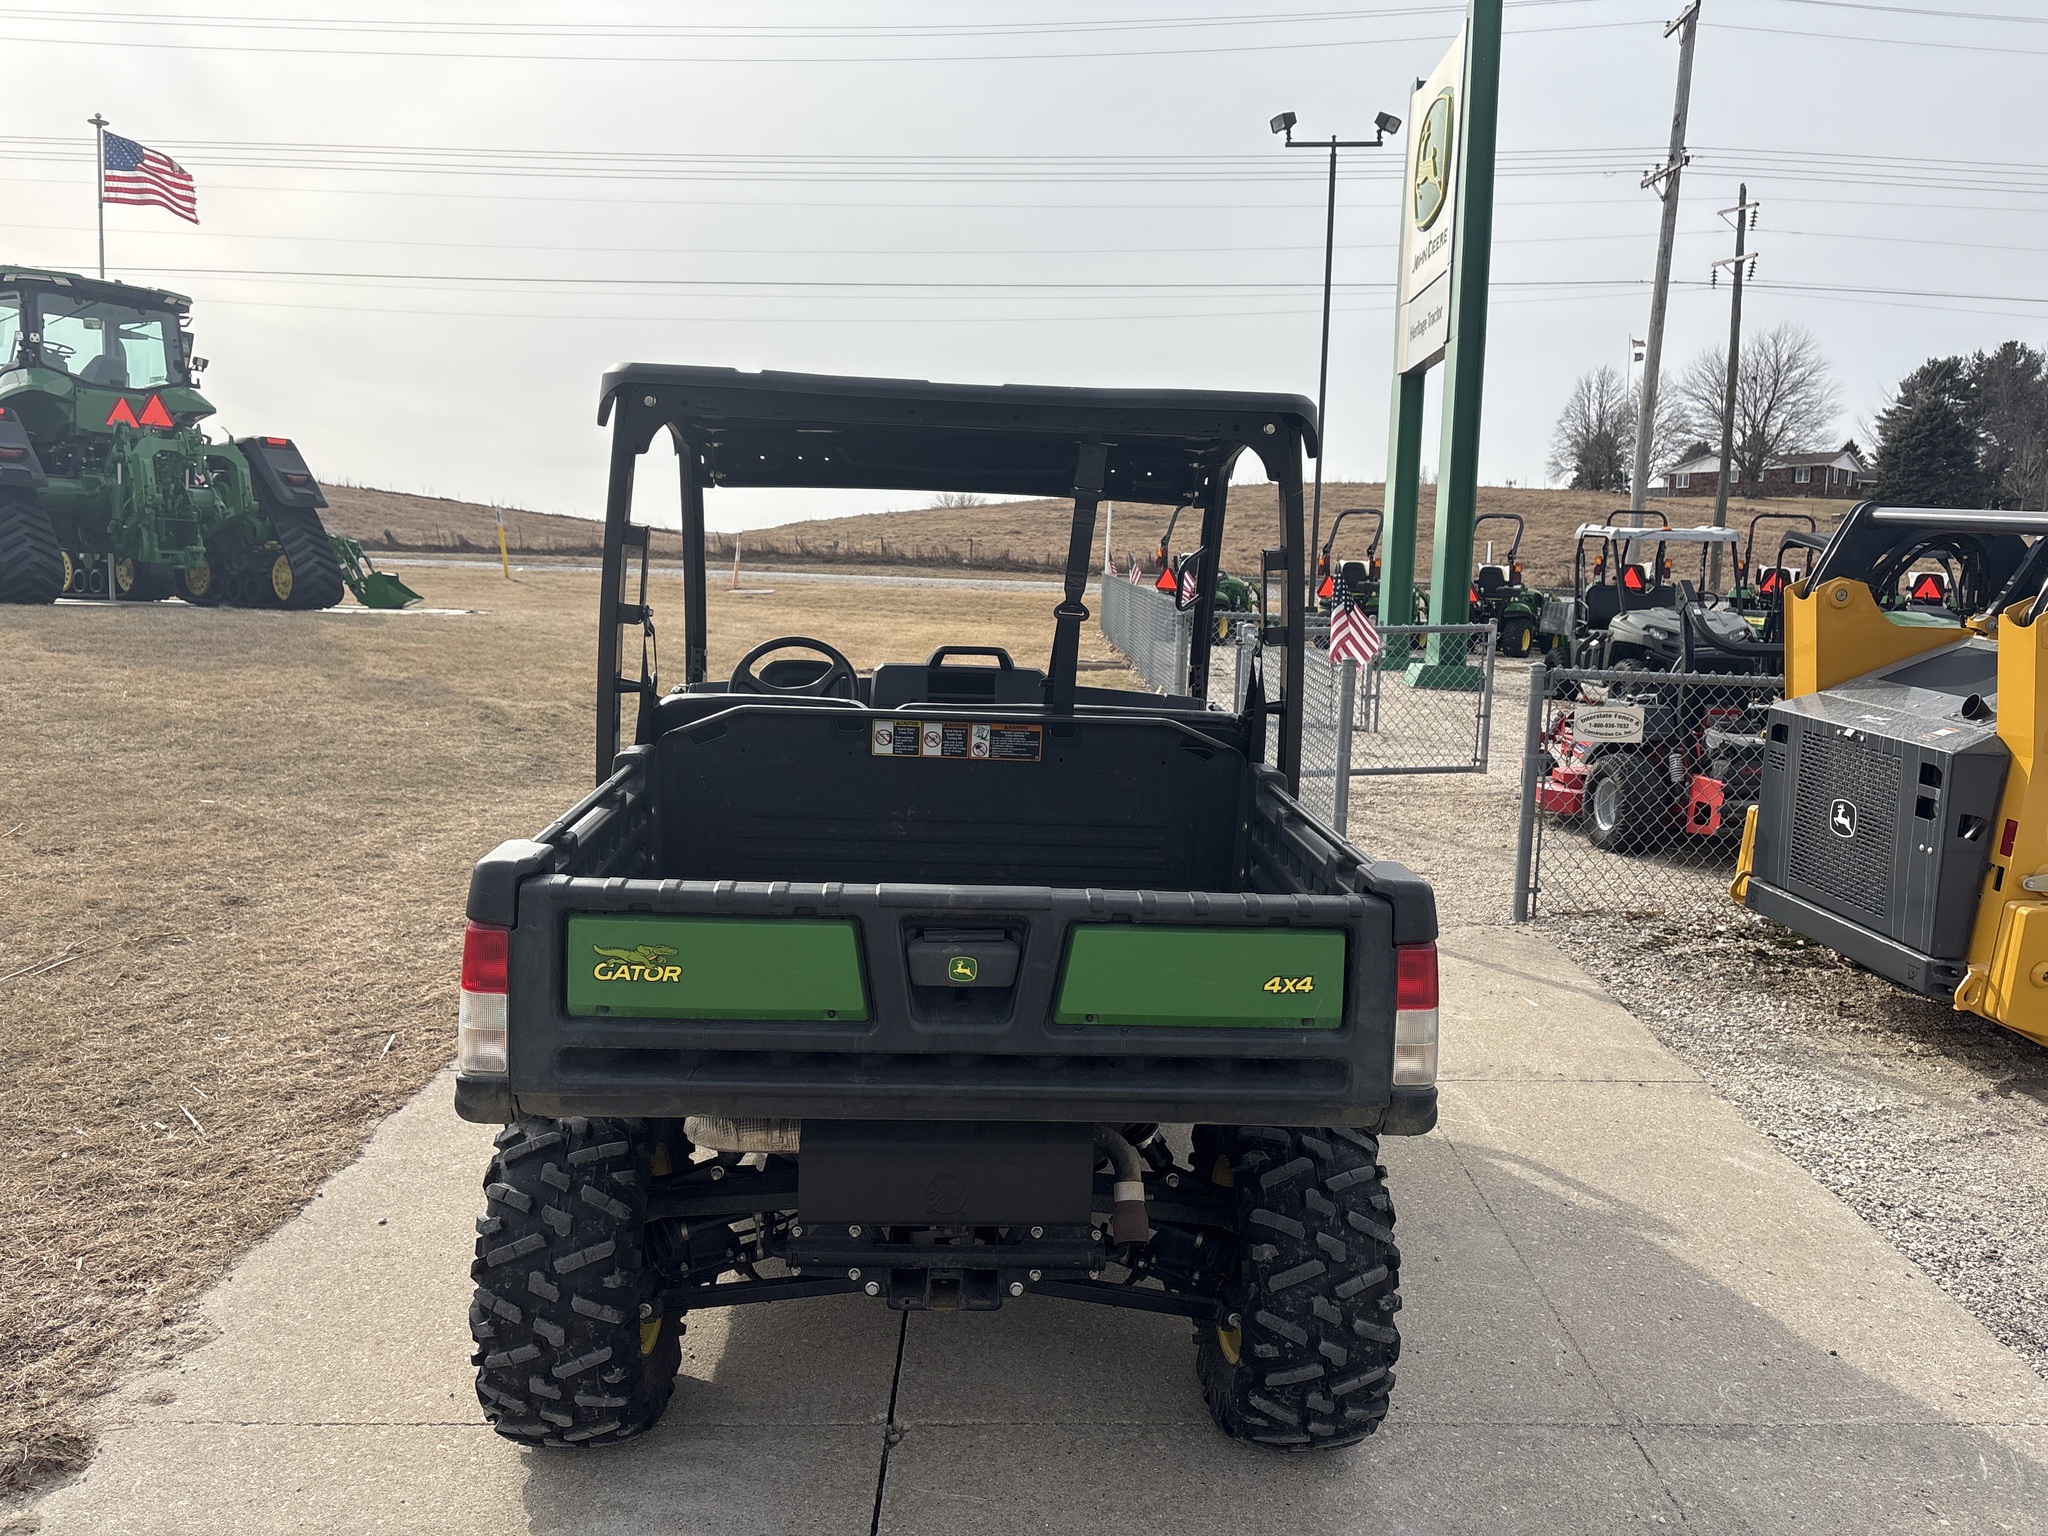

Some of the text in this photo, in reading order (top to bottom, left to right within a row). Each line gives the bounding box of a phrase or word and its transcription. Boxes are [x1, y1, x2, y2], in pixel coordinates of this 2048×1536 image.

[1412, 227, 1449, 274] JOHN DEERE
[1409, 305, 1443, 342] Heritage Tractor
[1580, 713, 1613, 724] Interstate
[1614, 713, 1634, 723] Fence
[1584, 728, 1614, 737] Construction
[593, 962, 683, 982] GATOR
